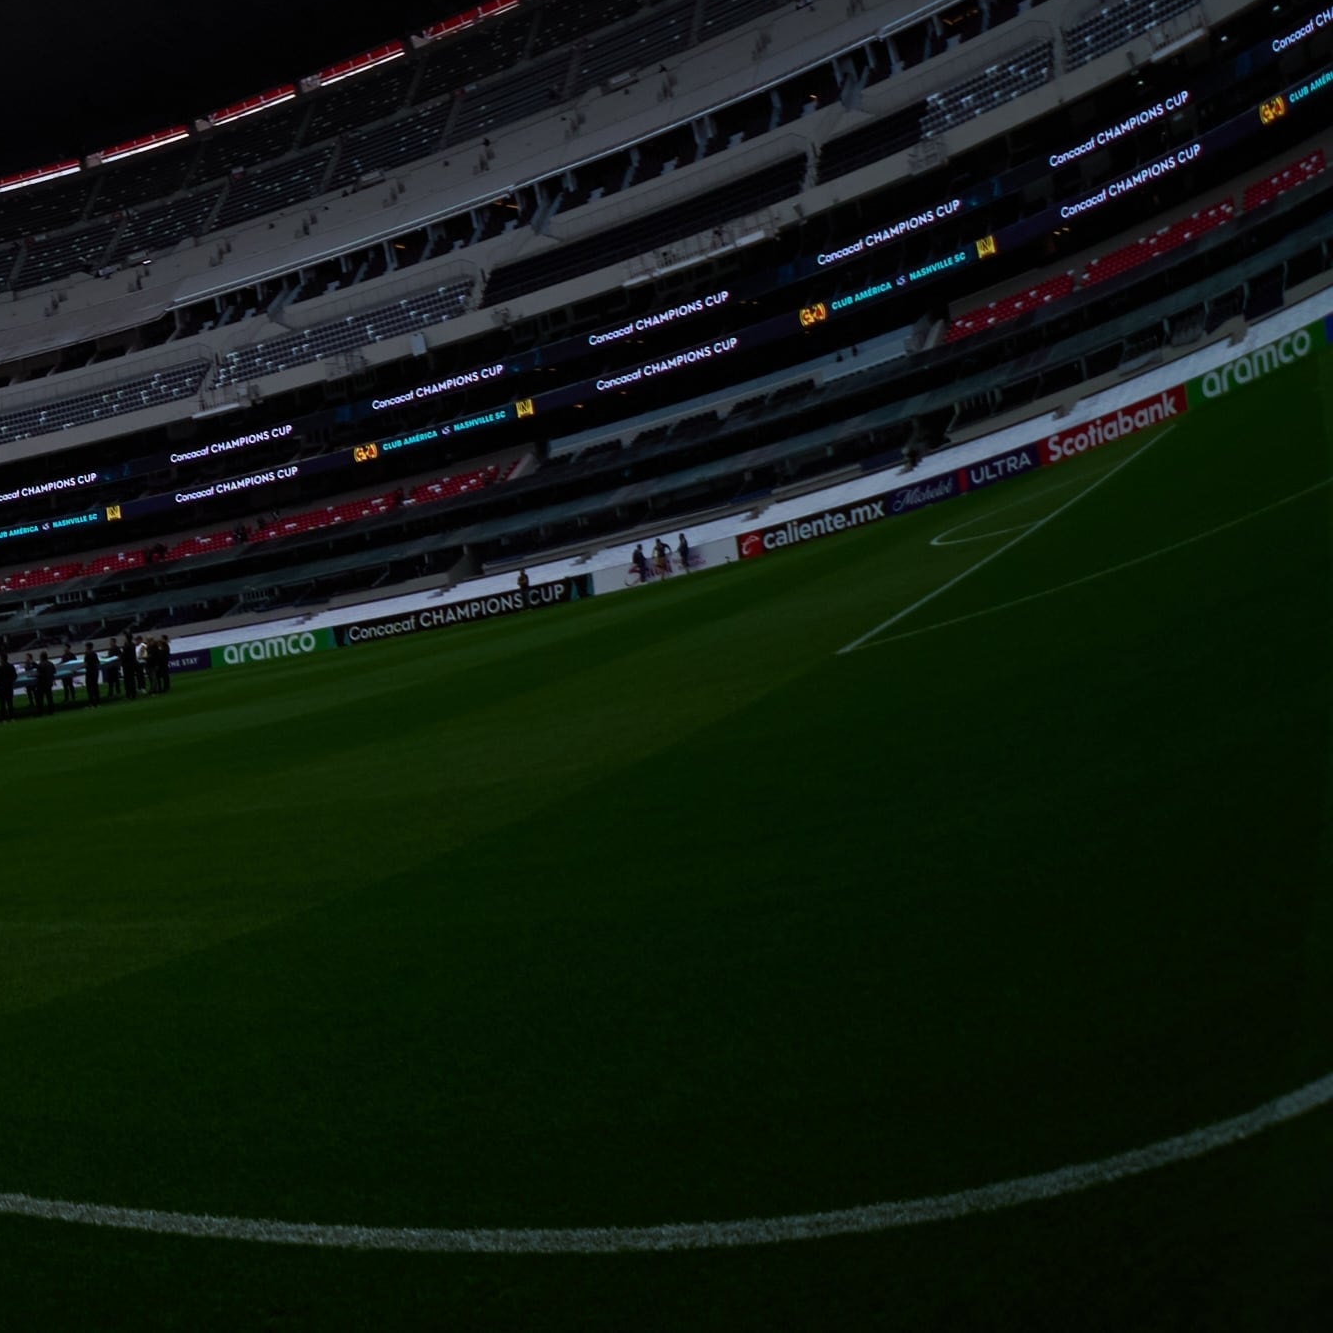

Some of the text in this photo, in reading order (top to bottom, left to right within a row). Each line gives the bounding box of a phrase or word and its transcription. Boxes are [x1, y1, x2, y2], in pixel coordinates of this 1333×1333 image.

[1273, 19, 1314, 52] Concacaf
[1289, 86, 1309, 103] CLUB
[1050, 91, 1188, 166] Concacaf CHAMPIONS CUP
[1061, 144, 1200, 218] Concacaf CHAMPIONS CUP
[818, 200, 960, 265] Concacaf CHAMPIONS CUP
[832, 252, 965, 310] CLUB AMÉRICA NASHVILLE SC
[589, 291, 728, 345] Concacaf CHAMPIONS CUP
[372, 365, 503, 409] Concacaf CHAMPIONS CUP
[597, 338, 737, 390] Concacaf CHAMPIONS CUP
[1200, 329, 1313, 400] aramco
[171, 425, 292, 462] Concacaf CHAMPIONS CUP
[383, 411, 506, 450] CLUB AMÉRICA NASHVILLE SC
[1047, 391, 1177, 462] Scotiabank
[21, 478, 75, 496] CHAMPIONS
[78, 473, 96, 484] CUP
[176, 466, 298, 502] Concacaf CHAMPIONS CUP
[970, 451, 1033, 484] ULTRA
[9, 526, 39, 536] AMÉRICA
[53, 515, 87, 528] NASHVILLE
[763, 497, 885, 551] caliente.mx
[348, 583, 565, 643] Concacaf CHAMPIONS CUP
[223, 631, 316, 666] aramco
